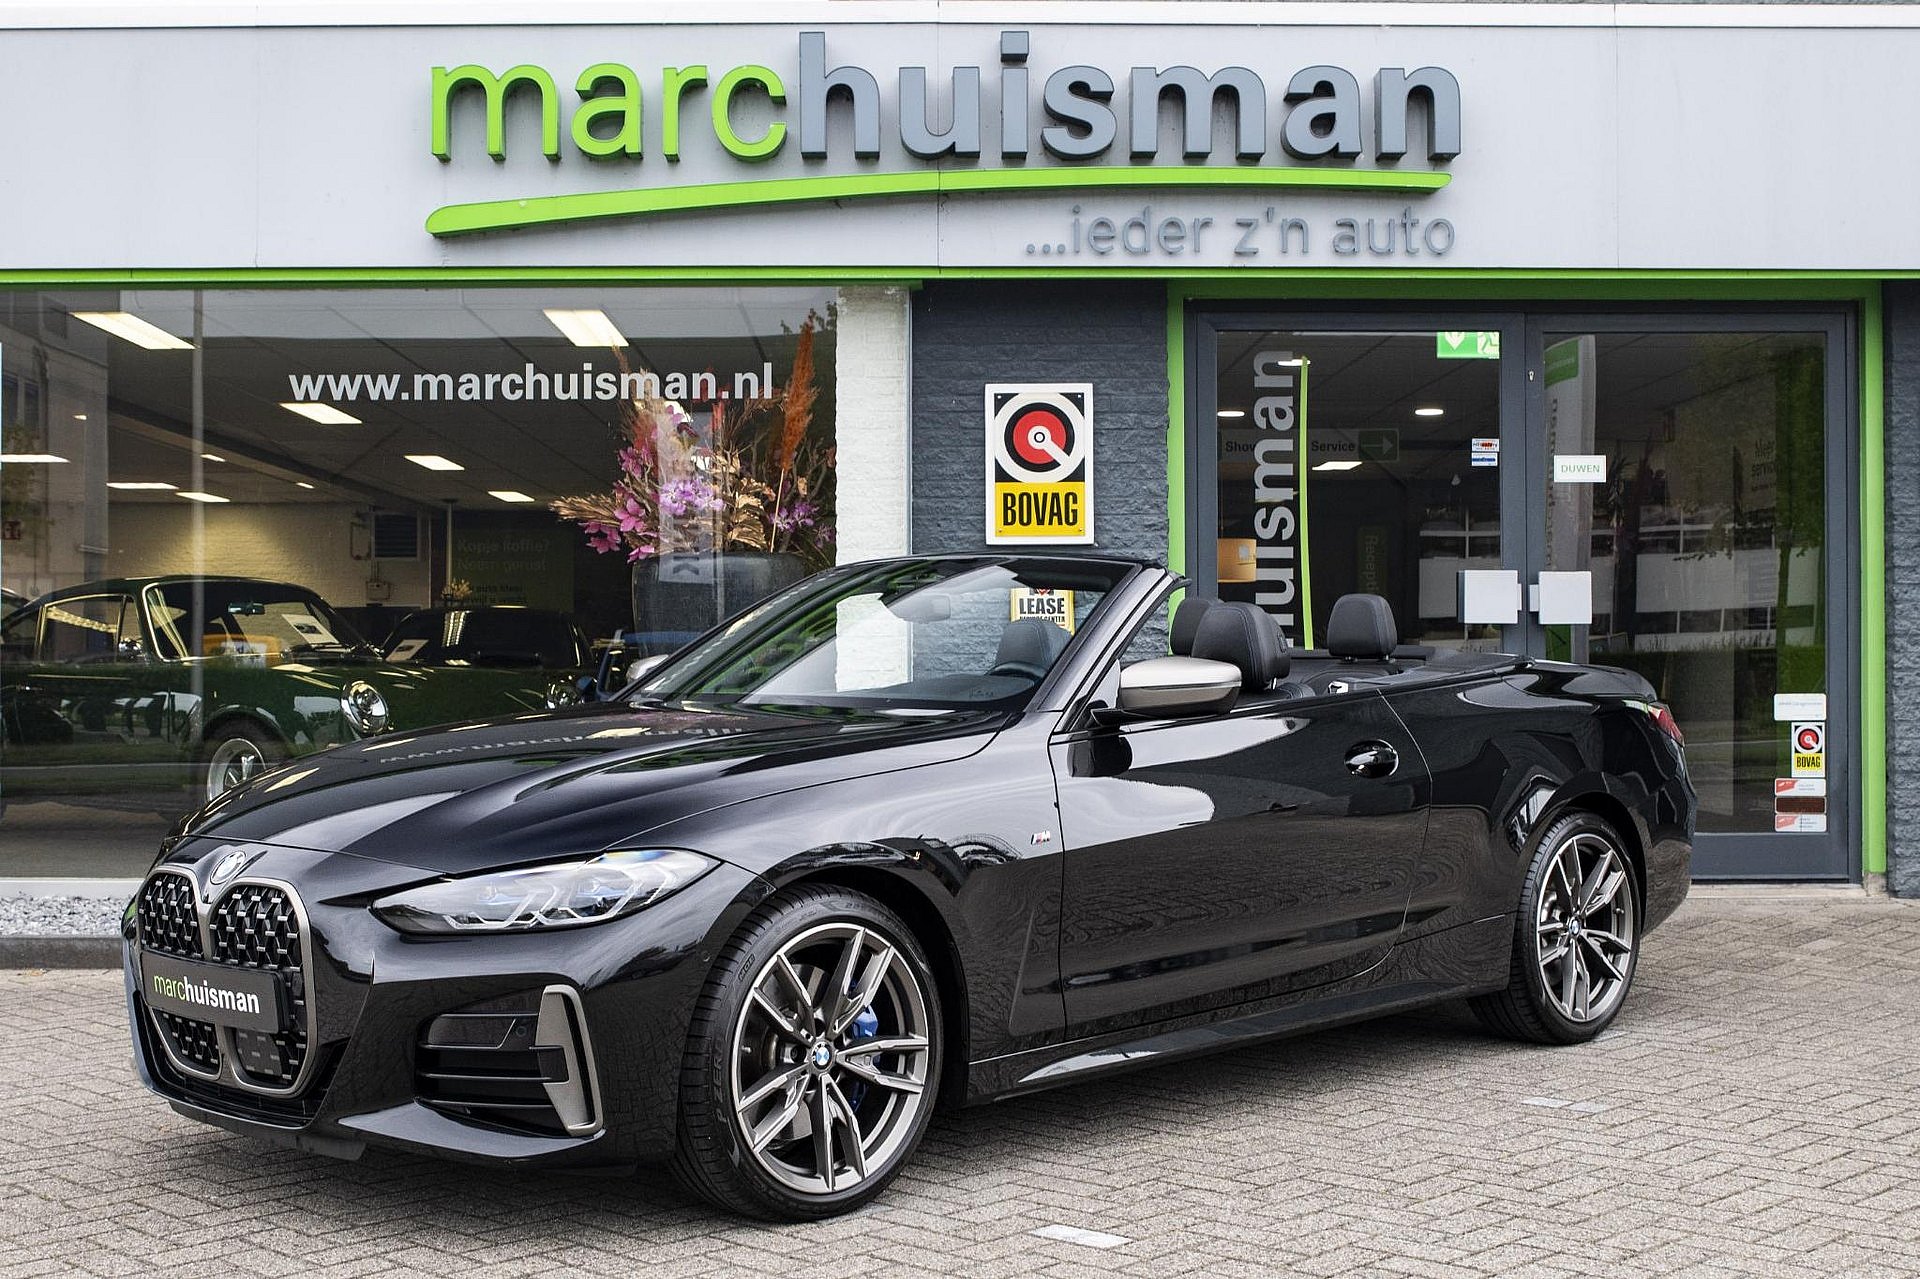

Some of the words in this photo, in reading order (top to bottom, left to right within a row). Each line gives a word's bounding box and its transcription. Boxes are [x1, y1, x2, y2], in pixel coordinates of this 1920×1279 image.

[431, 31, 1461, 163] marchuisman
[1234, 207, 1310, 255] z'n
[1332, 206, 1456, 255] auto
[288, 361, 775, 402] www.marchuisman.nl
[1310, 440, 1355, 453] Service
[1560, 464, 1601, 474] DUWEN
[1002, 492, 1079, 527] BOVAG
[1019, 598, 1066, 614] LEASE
[1796, 756, 1821, 768] BOVAG
[153, 975, 260, 1014] marchuisman
